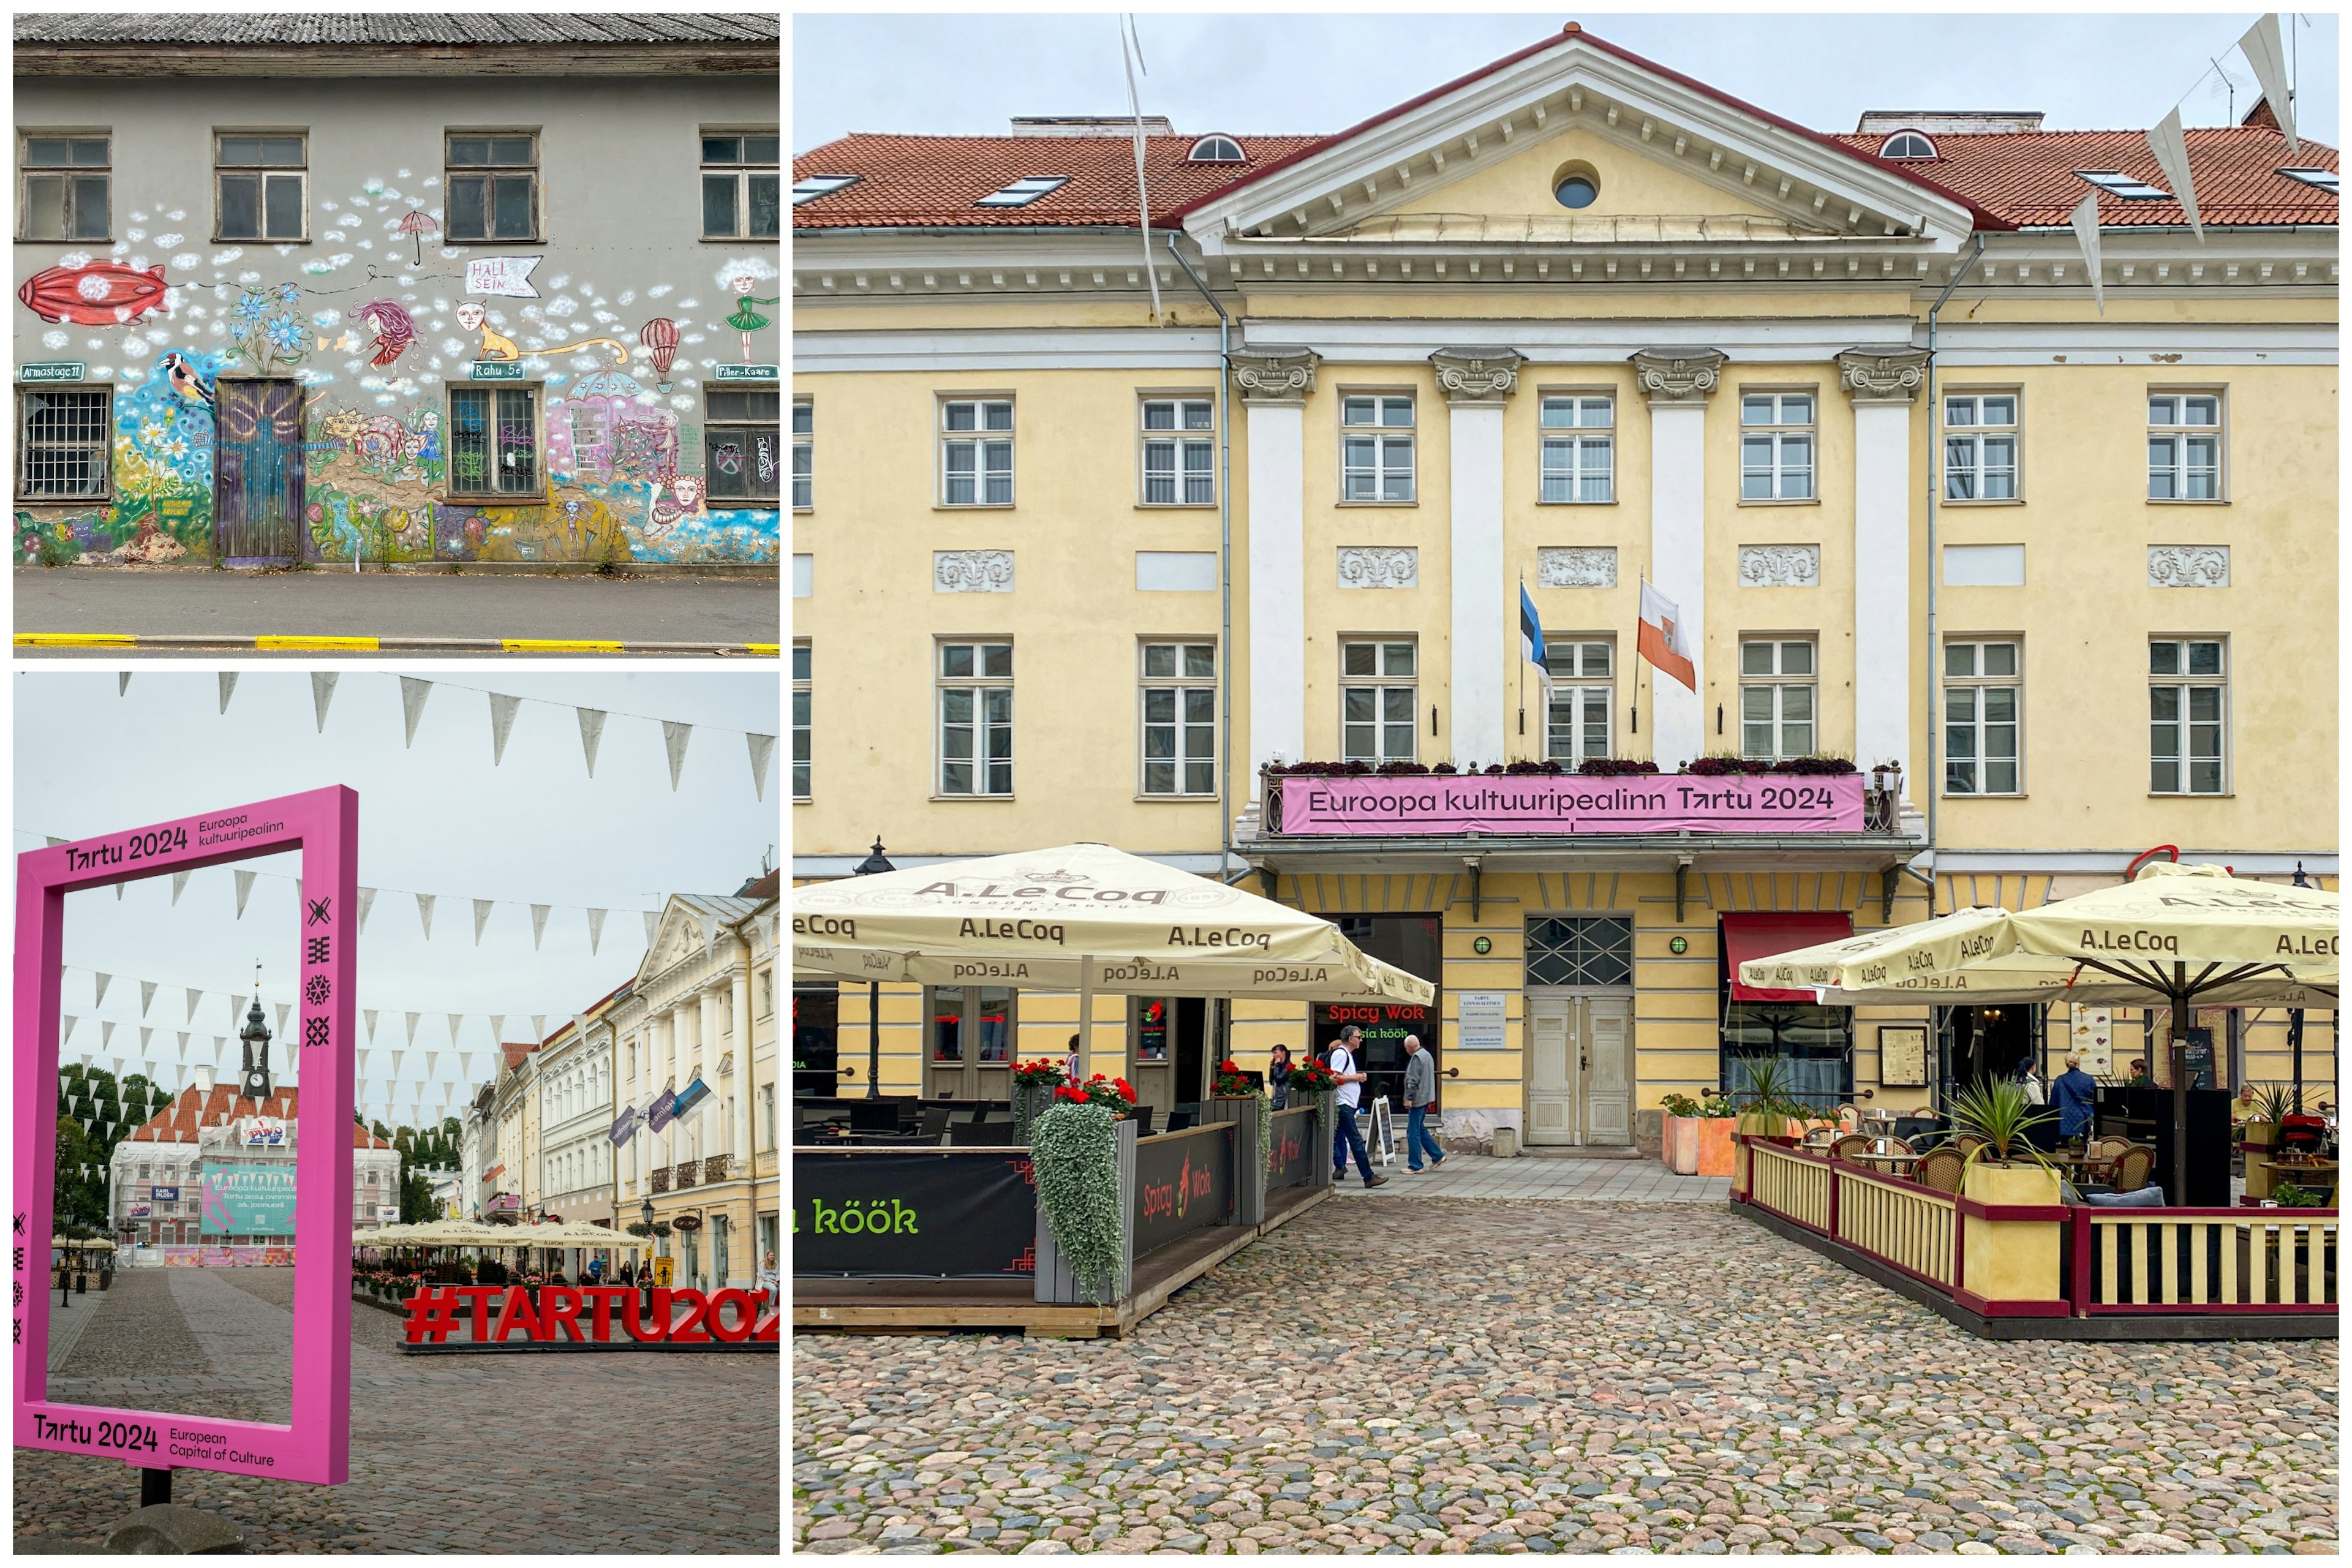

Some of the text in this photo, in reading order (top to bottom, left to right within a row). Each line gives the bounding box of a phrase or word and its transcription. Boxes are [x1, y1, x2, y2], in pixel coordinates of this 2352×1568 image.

[472, 262, 507, 277] HALL
[23, 366, 80, 379] Armastage 11
[476, 364, 521, 375] Rahu 5e
[1310, 787, 1834, 816] Euroopa kultuuripealinn Tartu 2024
[199, 814, 247, 832] Euroopa
[199, 821, 284, 846] kultuuripealinn
[66, 827, 187, 871] Tartu 2024
[1329, 1004, 1425, 1024] Spicy Wok
[1360, 1028, 1408, 1038] sia köök
[1143, 1164, 1212, 1223] Spicy Wok
[813, 1198, 919, 1234] köök
[34, 1414, 158, 1452] Tartu 2024
[170, 1428, 227, 1445] European
[170, 1444, 274, 1466] Capital of Culture
